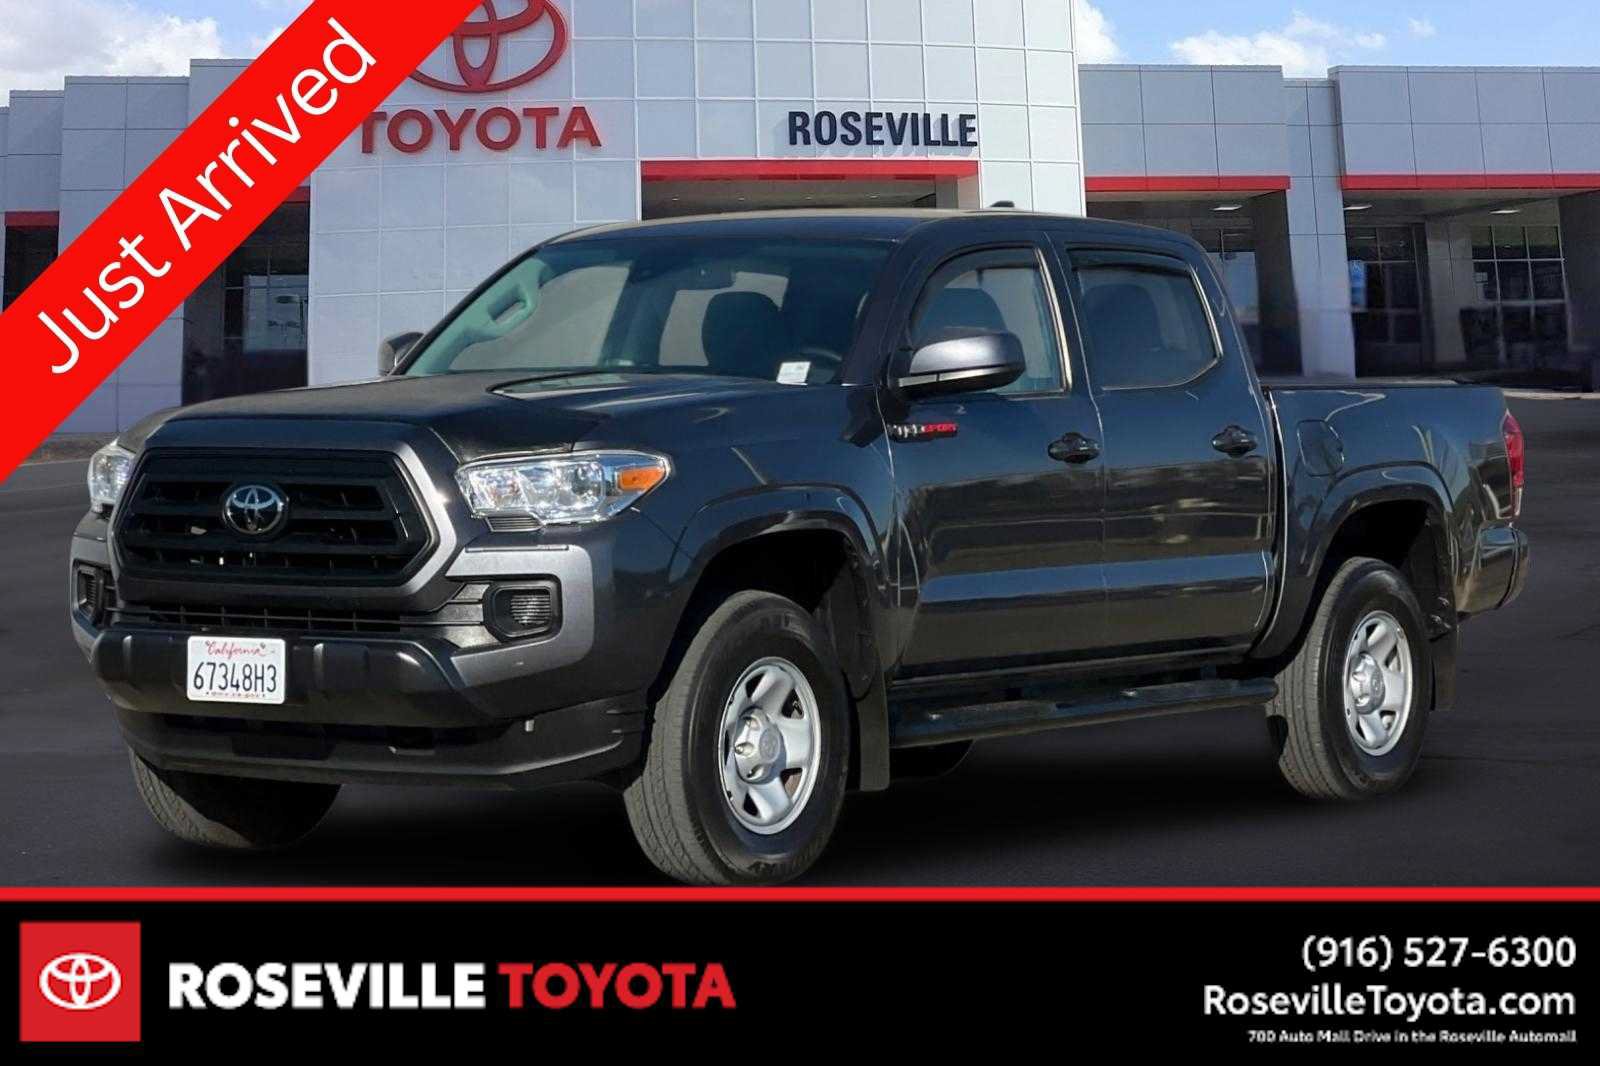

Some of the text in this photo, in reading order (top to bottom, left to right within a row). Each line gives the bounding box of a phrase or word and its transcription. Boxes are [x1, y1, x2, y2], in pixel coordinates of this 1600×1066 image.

[361, 106, 602, 154] TOYOTA
[788, 110, 977, 147] ROSEVILLE
[206, 640, 266, 660] California
[193, 661, 277, 692] 67348H3
